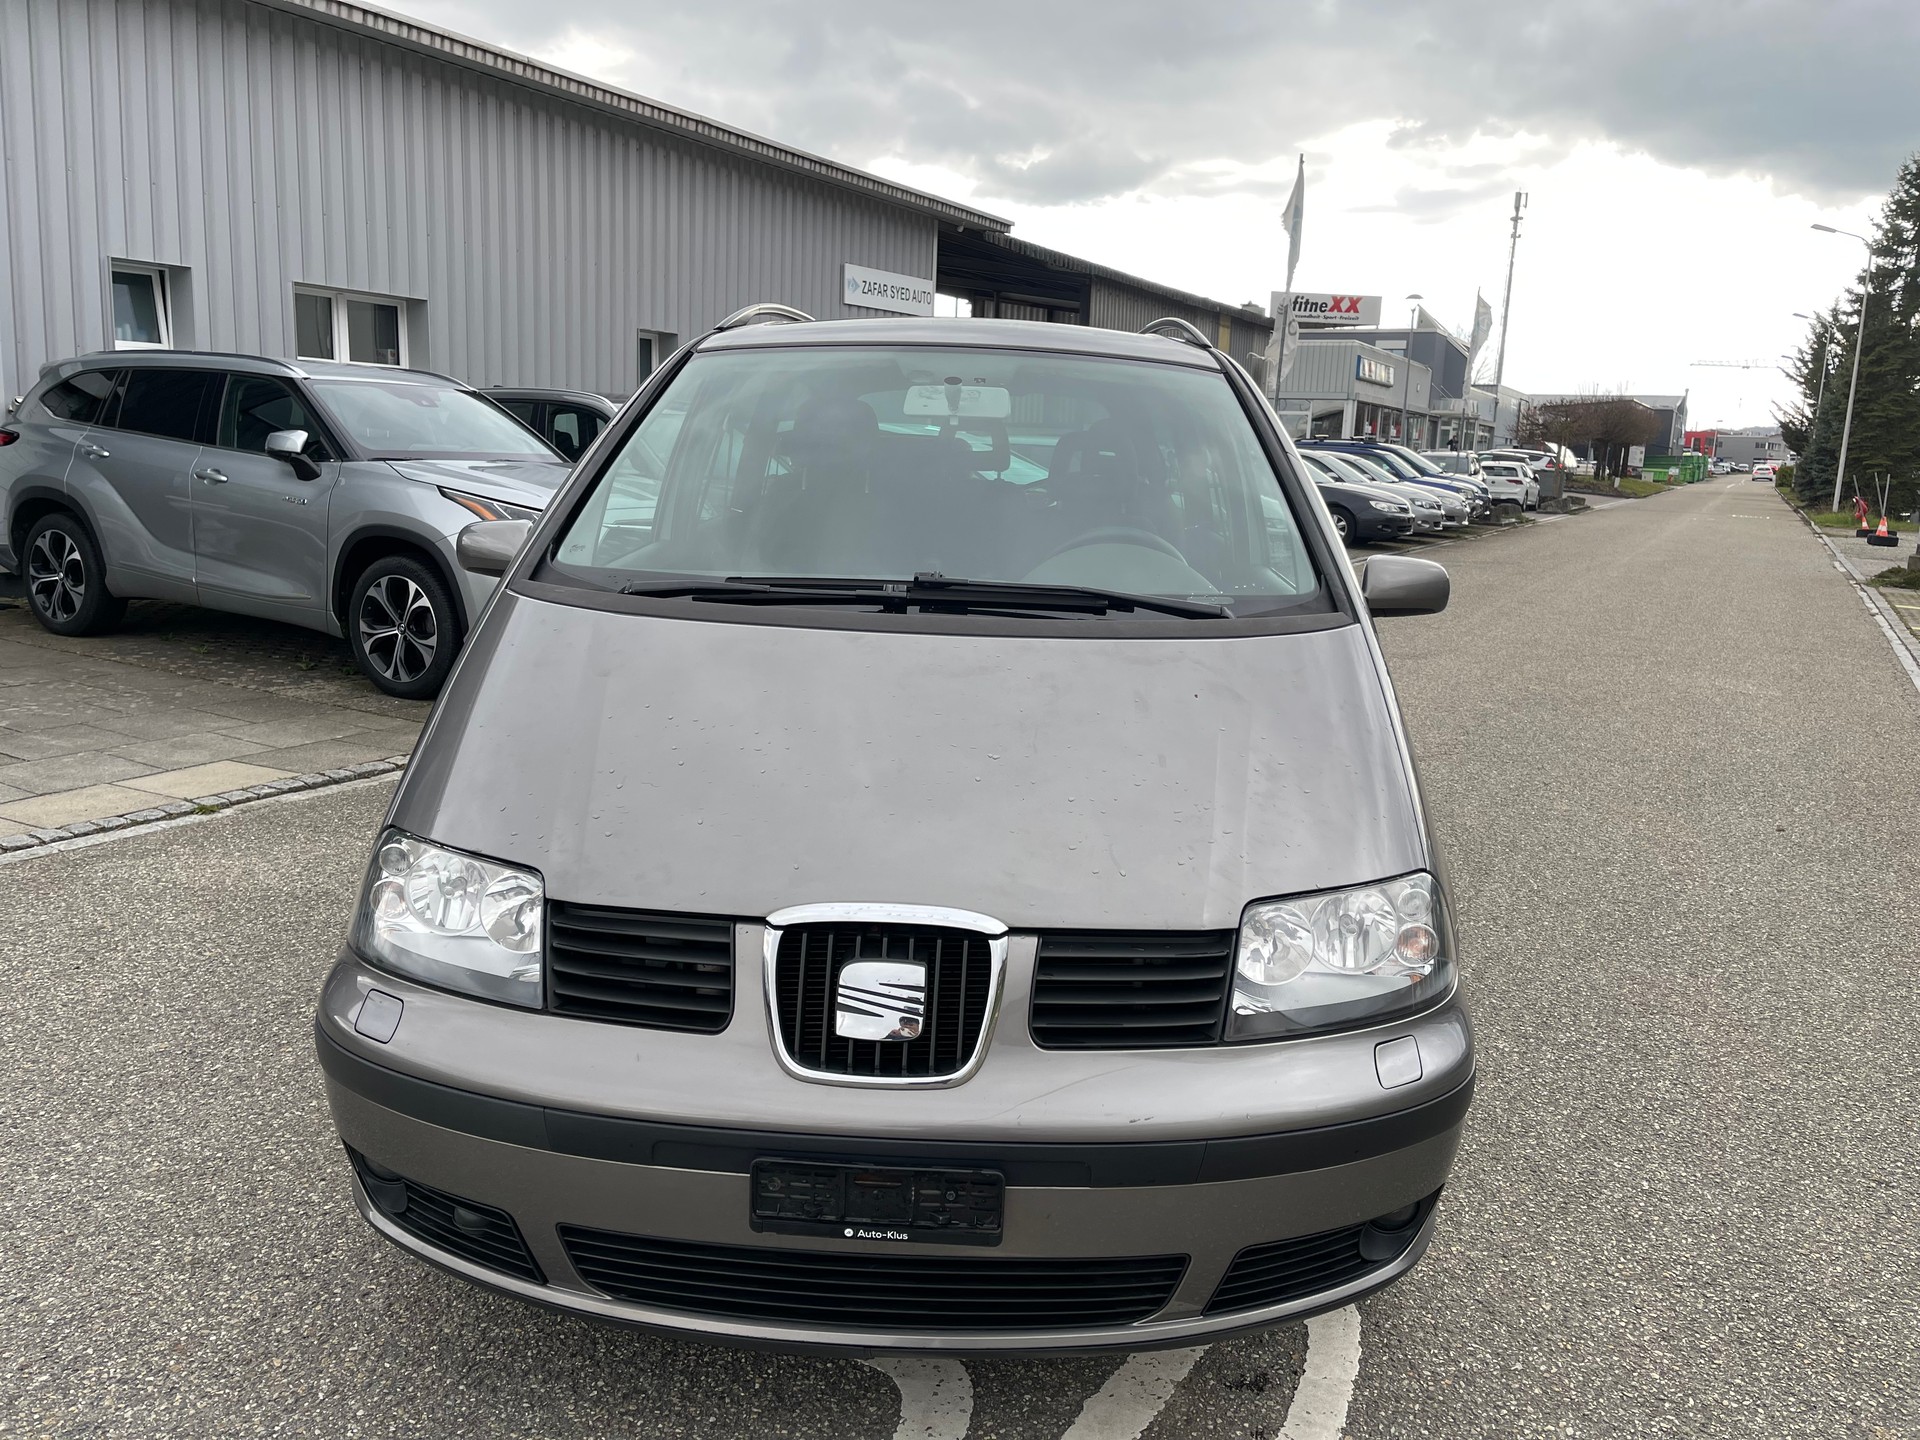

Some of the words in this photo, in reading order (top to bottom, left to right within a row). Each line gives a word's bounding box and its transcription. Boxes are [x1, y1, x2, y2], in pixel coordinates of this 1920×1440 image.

[862, 280, 888, 297] ZAFAR
[890, 285, 910, 301] SYED
[912, 289, 931, 304] AUTO
[1293, 295, 1362, 313] fitneXX
[857, 1229, 908, 1240] Auto-Klus
